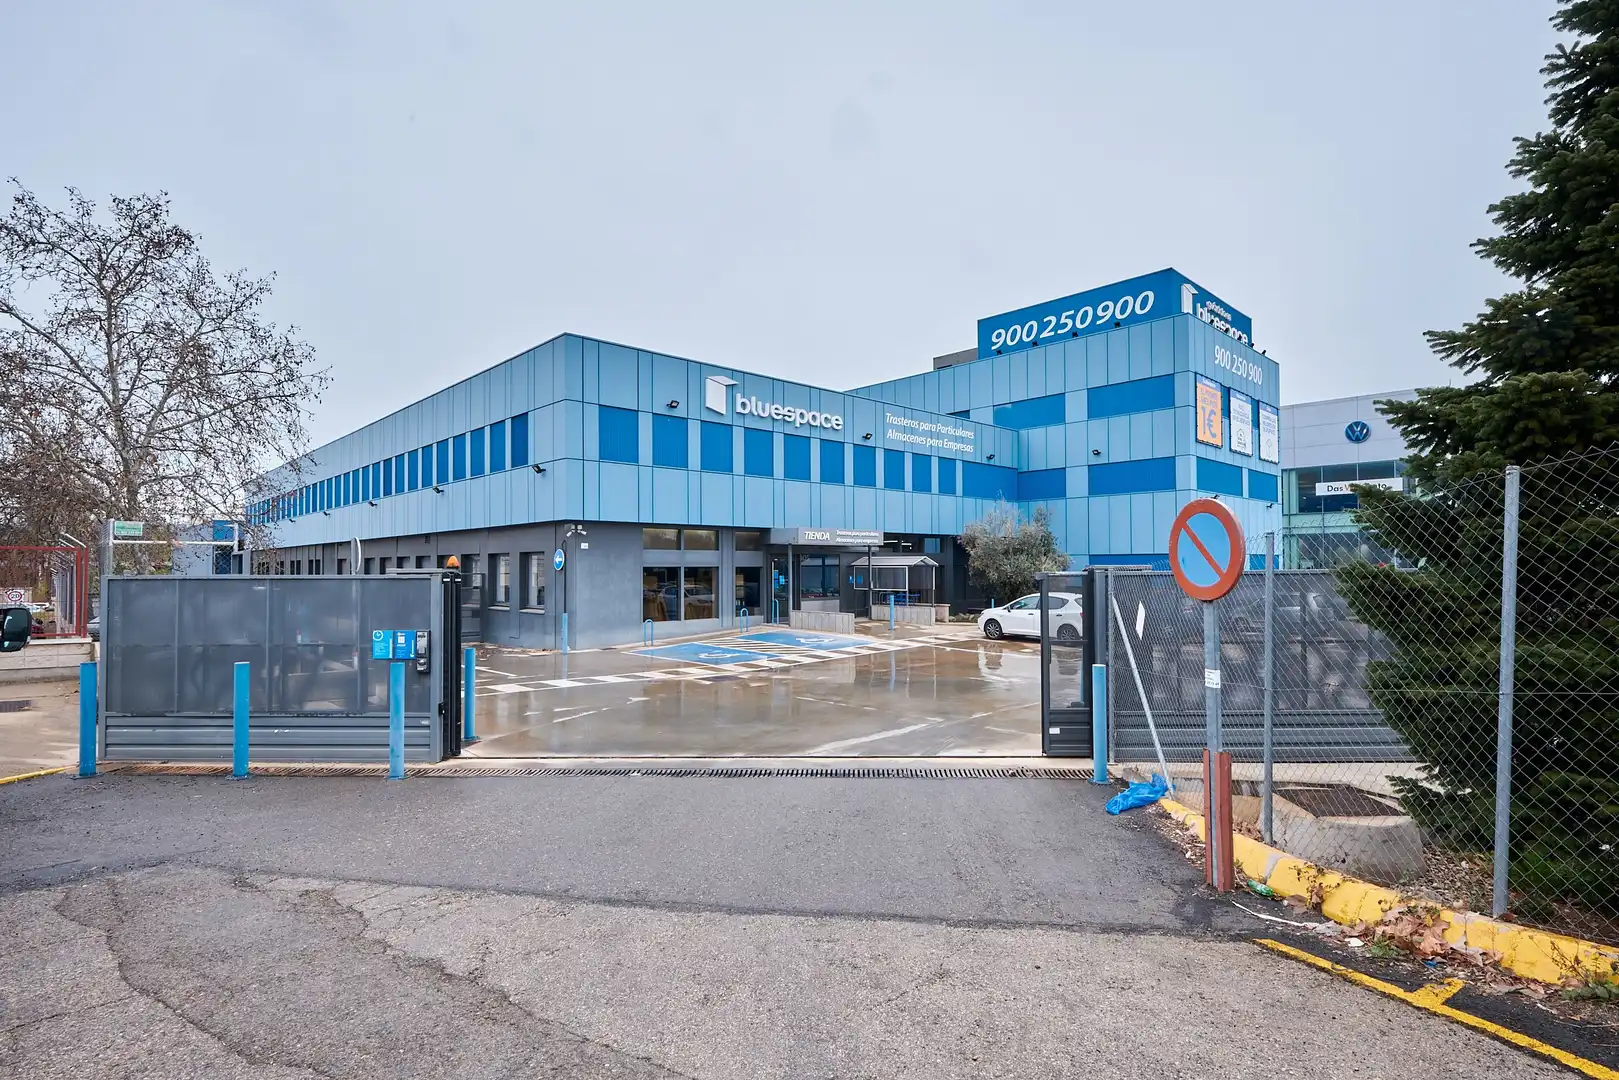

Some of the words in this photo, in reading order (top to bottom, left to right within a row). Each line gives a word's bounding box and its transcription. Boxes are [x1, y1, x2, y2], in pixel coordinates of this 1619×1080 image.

[991, 320, 1038, 350] 900
[1040, 306, 1093, 338] 250
[1096, 290, 1155, 325] 900
[1214, 345, 1230, 369] 900
[1232, 354, 1247, 378] 250
[1248, 363, 1263, 385] 900
[735, 393, 843, 430] bluespace
[886, 413, 919, 429] Trasteros
[919, 422, 936, 432] para
[937, 423, 975, 439] Particulares
[1201, 406, 1217, 438] 1€
[886, 429, 926, 445] Almacenes
[926, 438, 942, 447] para
[943, 439, 974, 452] Empresas
[804, 531, 830, 541] TIENDA
